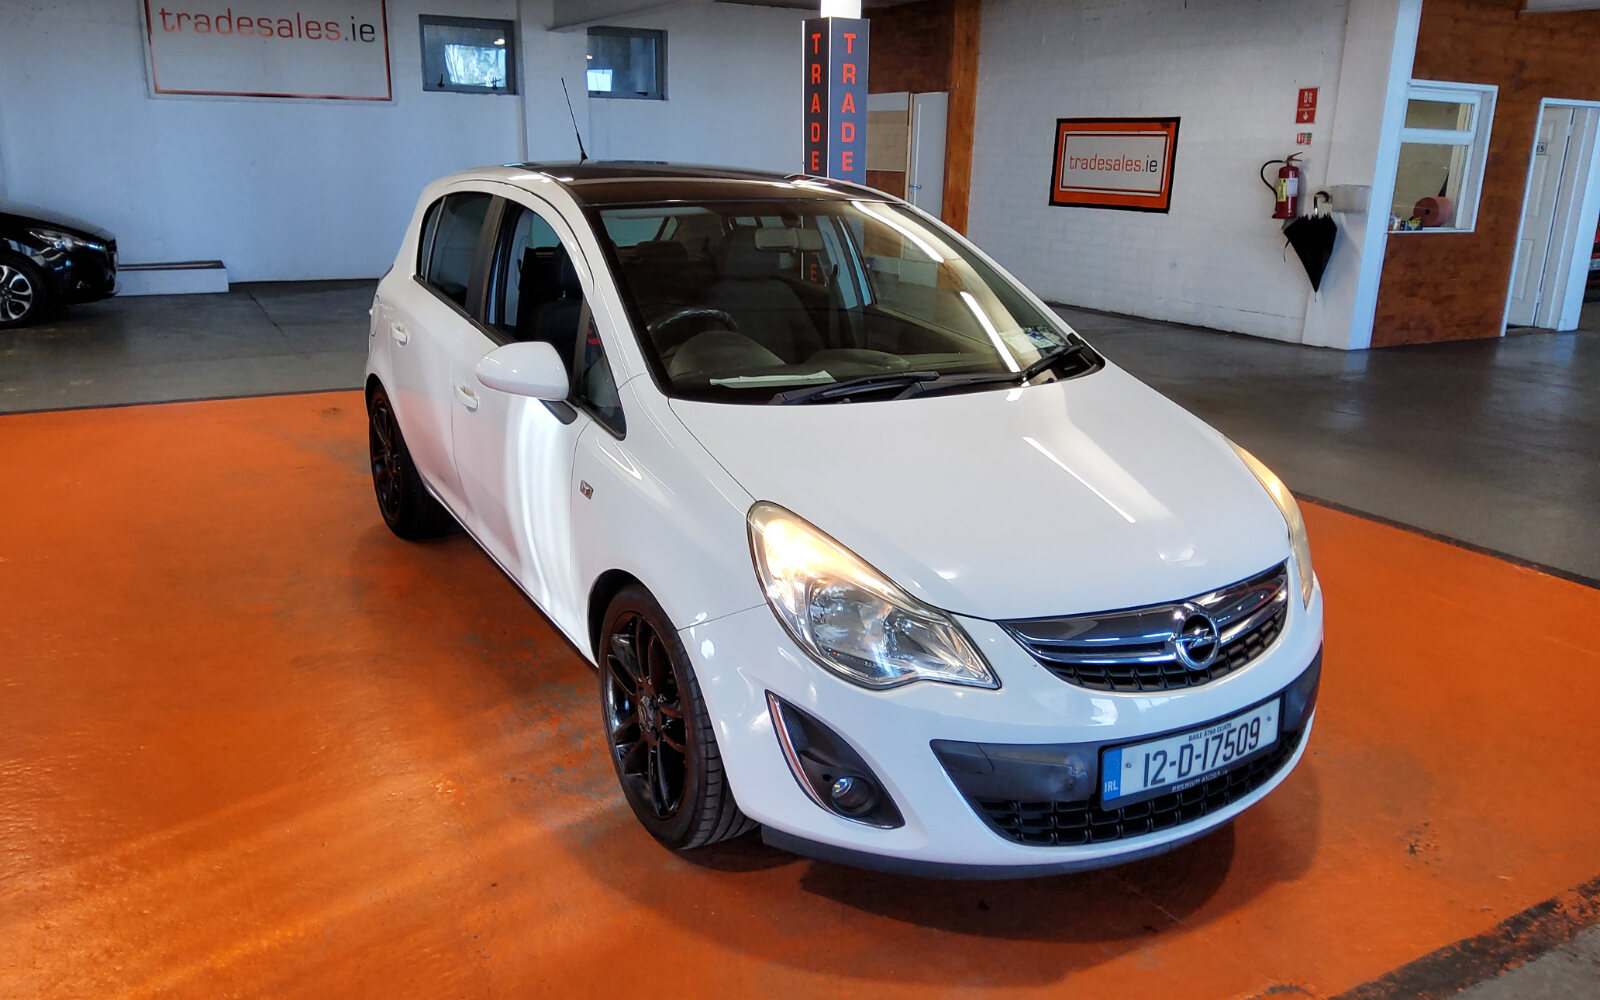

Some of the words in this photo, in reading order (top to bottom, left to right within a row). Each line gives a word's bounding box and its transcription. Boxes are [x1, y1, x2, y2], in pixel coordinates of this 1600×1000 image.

[158, 7, 376, 43] tradesales.ie
[810, 33, 821, 171] TRADE
[841, 33, 857, 171] TRADE
[1069, 153, 1158, 173] tradesales.ie
[1143, 716, 1261, 788] 12-D-17509
[1104, 780, 1119, 793] IRL
